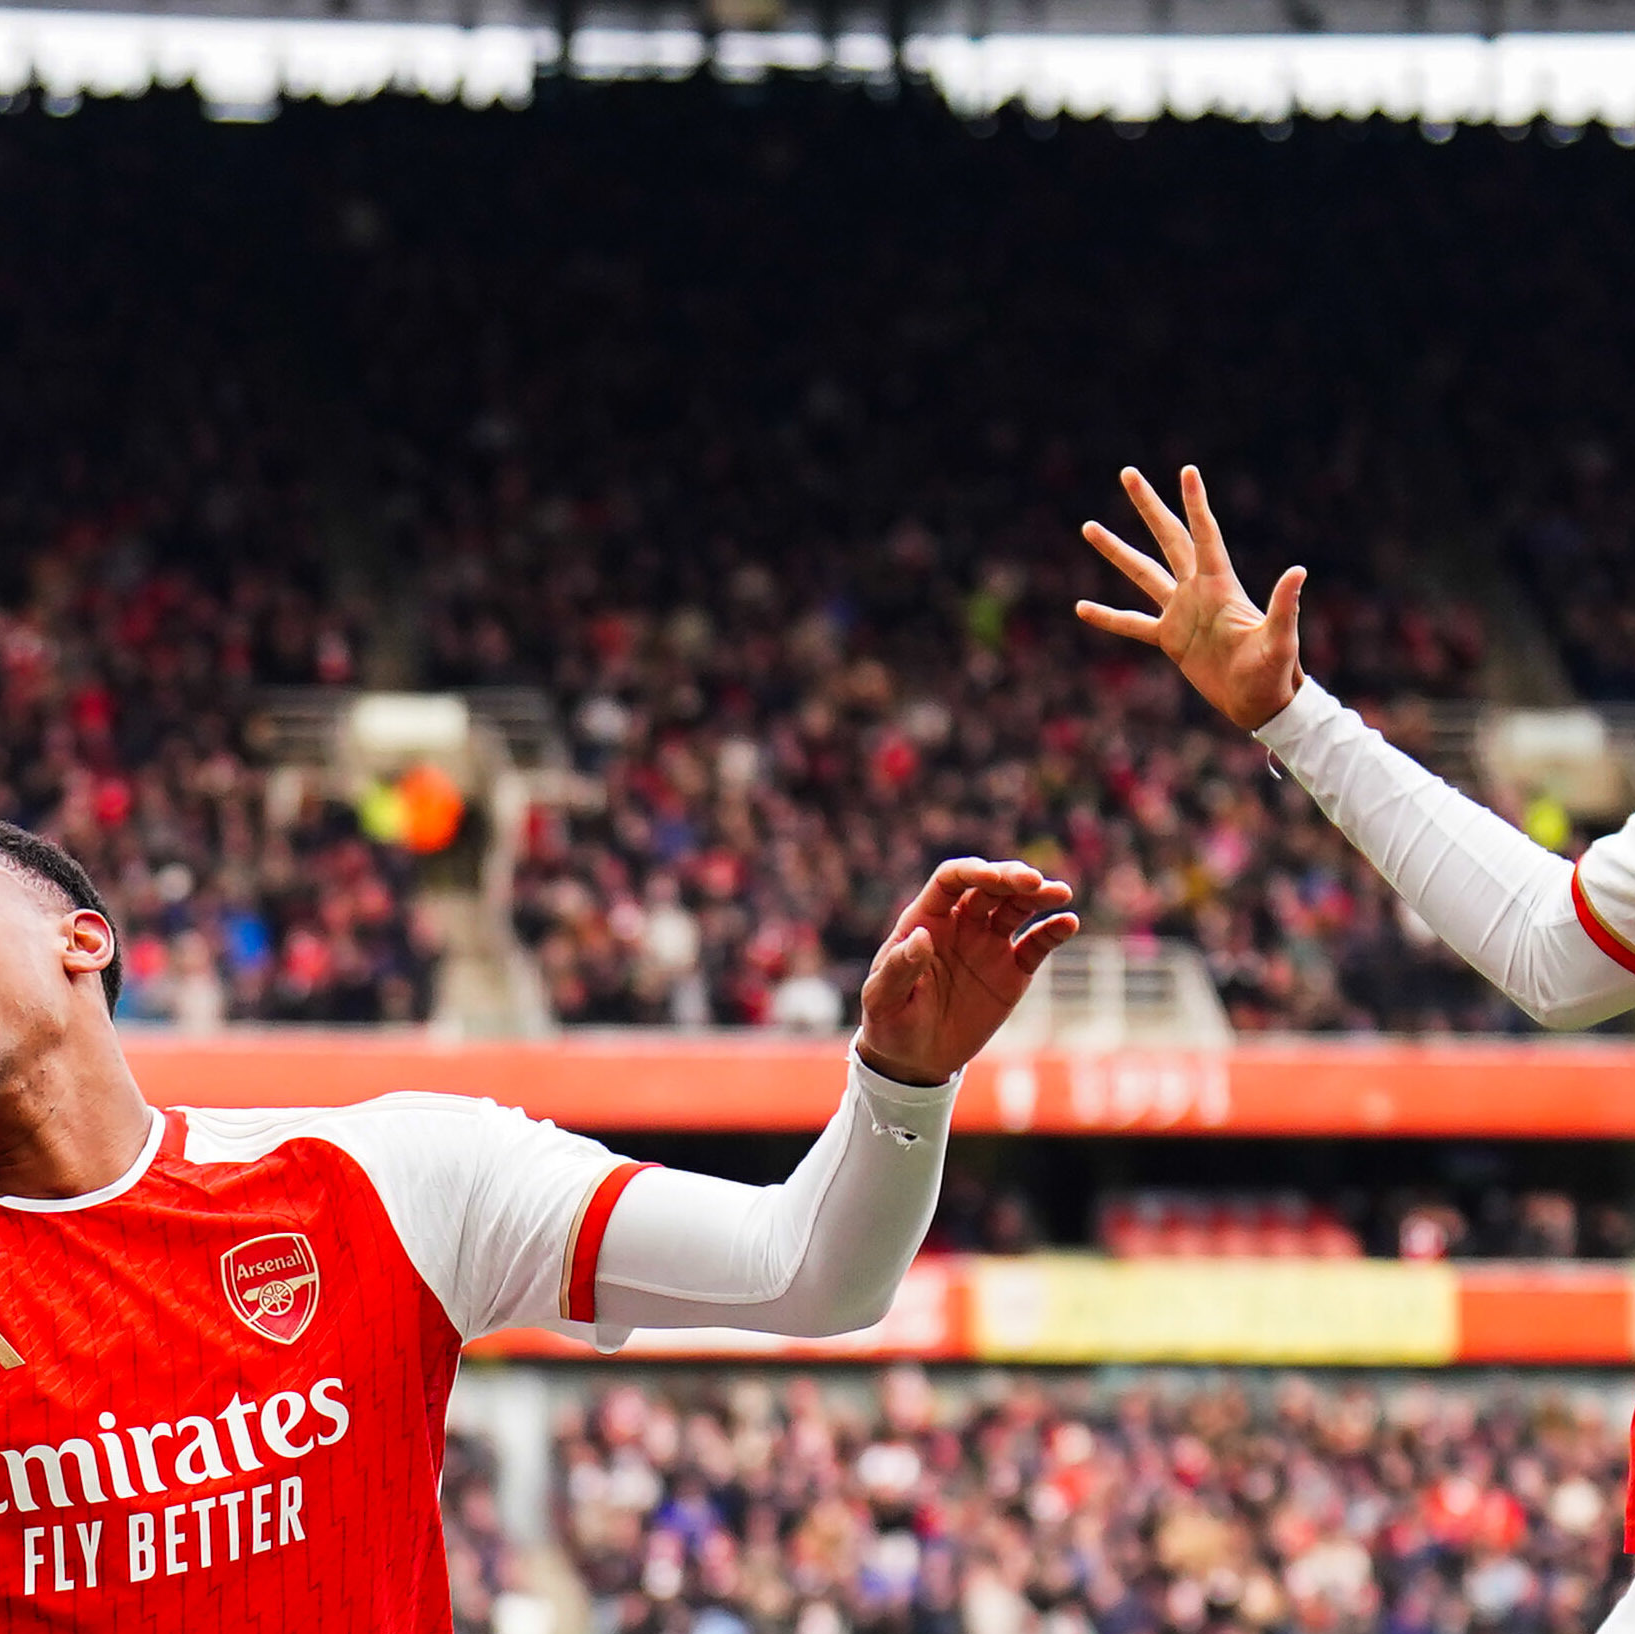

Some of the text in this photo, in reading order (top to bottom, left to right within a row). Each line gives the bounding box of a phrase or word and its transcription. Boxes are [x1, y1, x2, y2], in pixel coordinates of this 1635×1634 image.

[237, 1248, 303, 1281] Arsenal
[23, 1475, 306, 1596] FLY BETTER
